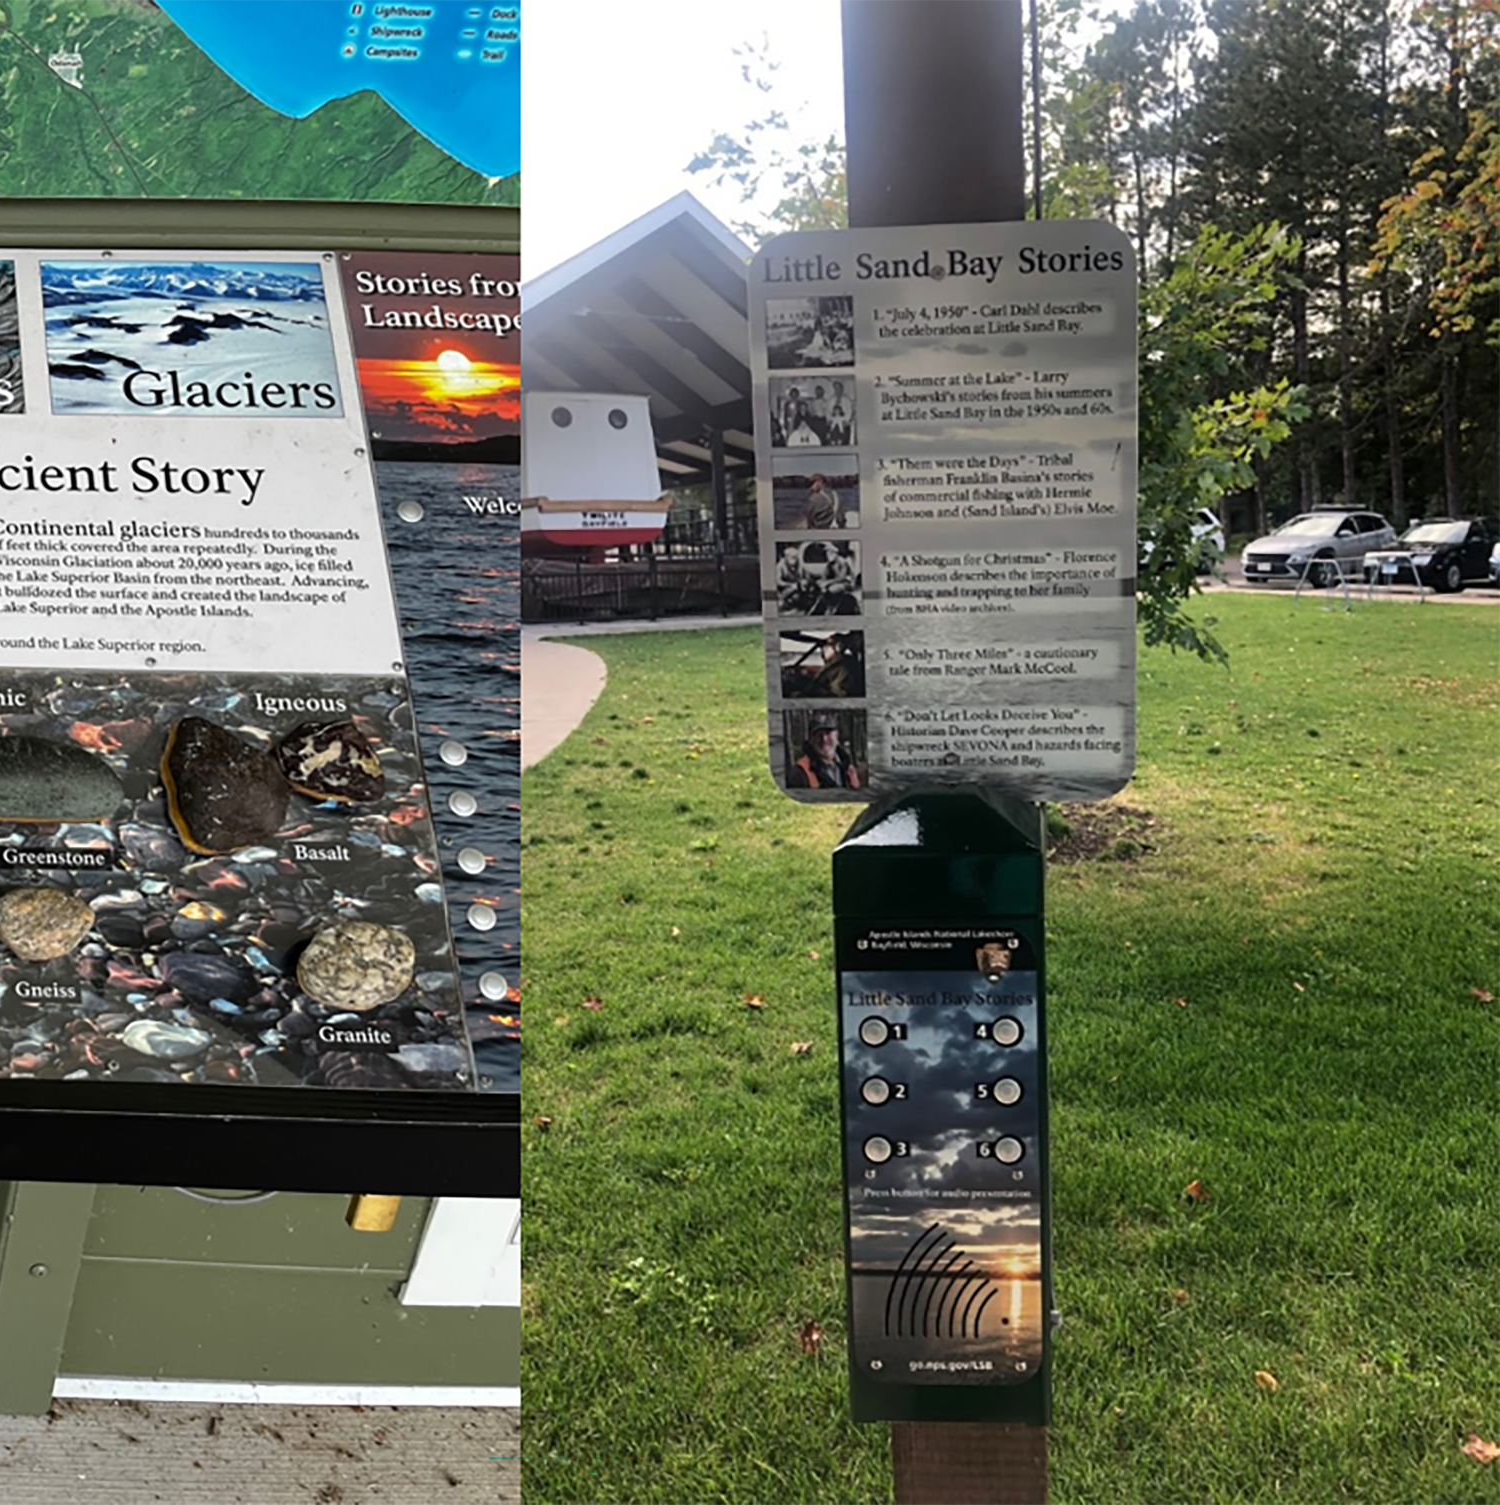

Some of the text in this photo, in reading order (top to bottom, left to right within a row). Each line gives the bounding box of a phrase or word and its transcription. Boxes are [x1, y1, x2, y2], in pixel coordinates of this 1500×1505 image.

[375, 6, 432, 18] Lighthouse
[491, 9, 517, 19] Dock
[371, 27, 423, 38] Shipwreck
[486, 30, 518, 40] Roads
[366, 47, 418, 59] Campsites
[482, 50, 505, 60] Trail
[766, 248, 1123, 283] Little Sand Bay Stories
[356, 271, 521, 297] Stories fro
[873, 309, 883, 320] 1.
[919, 307, 931, 320] 4,
[979, 304, 1007, 317] Carl
[1010, 302, 1040, 316] Dahl
[1043, 302, 1102, 315] describes
[878, 319, 1082, 337] the celebration at Little Sand Bay.
[123, 371, 335, 409] Glaciers
[131, 457, 265, 504] Story
[462, 496, 521, 514] Welc
[120, 521, 201, 542] glaciers
[204, 527, 269, 538] hundreds
[272, 530, 286, 538] to
[289, 529, 359, 539] thousands
[911, 555, 961, 568] Shotgun
[963, 553, 981, 565] for
[1063, 551, 1116, 563] Florence
[29, 602, 88, 616] Superior
[92, 603, 117, 614] and
[120, 603, 142, 615] the
[145, 605, 197, 618] Apostle
[200, 605, 253, 616] Islands.
[38, 637, 59, 649] the
[62, 637, 94, 649] Lake
[97, 639, 155, 653] Superior
[159, 642, 205, 653] region.
[889, 662, 1076, 677] tale from Ranger Mark McCool.
[256, 693, 346, 714] Igneous
[3, 847, 105, 866] Greenstone
[295, 844, 350, 862] Basalt
[15, 981, 76, 999] Gneiss
[849, 991, 1033, 1009] Little Sand Bay Stories
[319, 1026, 391, 1044] Granite
[893, 1025, 902, 1038] 1
[976, 1025, 987, 1038] 4
[895, 1085, 905, 1098] 2
[978, 1085, 987, 1098] 5
[897, 1143, 906, 1156] 3
[980, 1143, 990, 1156] 6
[863, 1188, 1031, 1199] Press button for audio presentation
